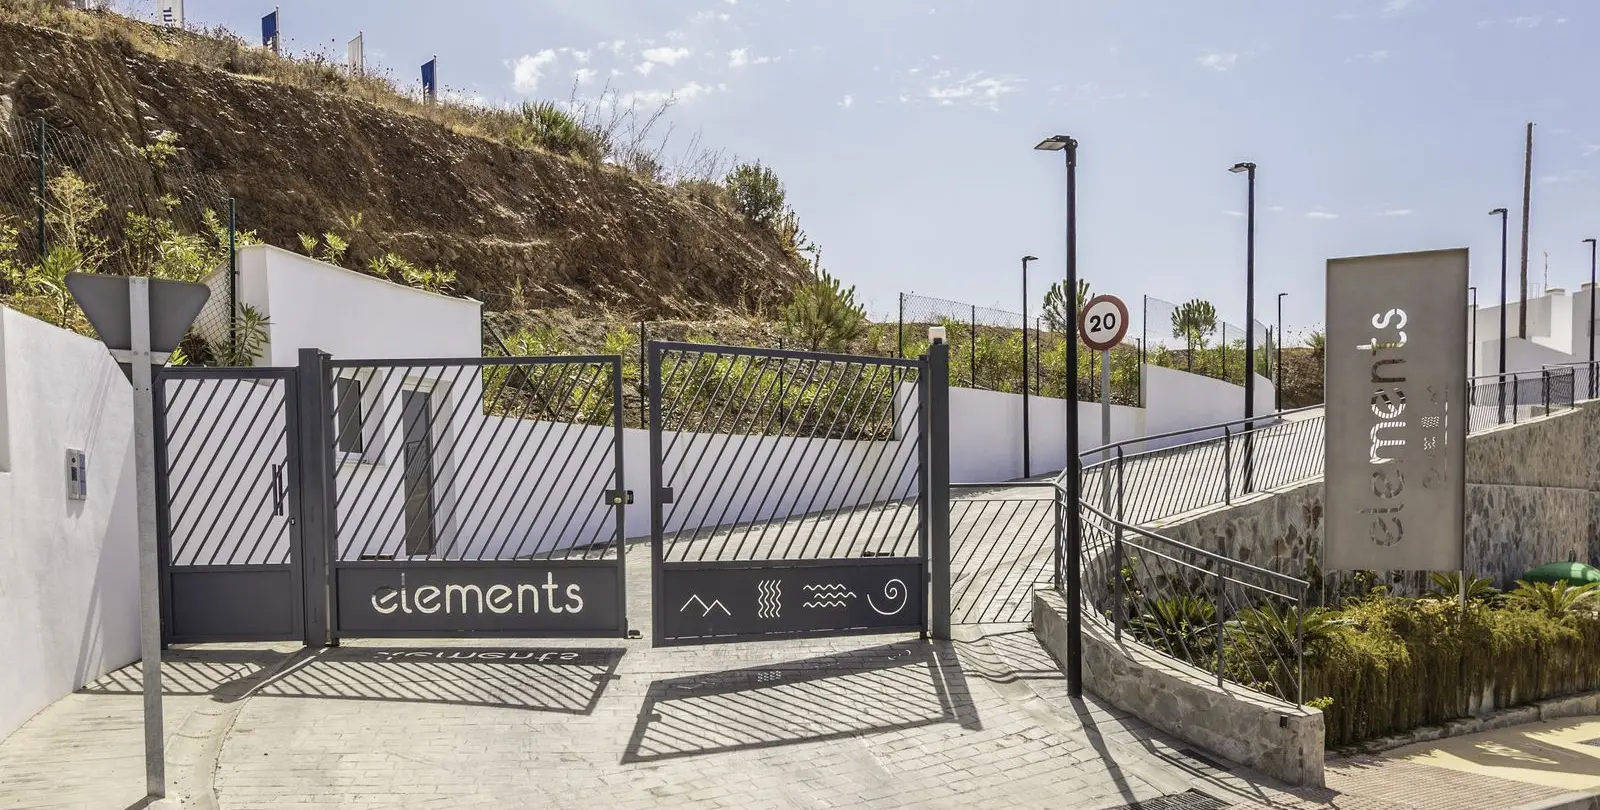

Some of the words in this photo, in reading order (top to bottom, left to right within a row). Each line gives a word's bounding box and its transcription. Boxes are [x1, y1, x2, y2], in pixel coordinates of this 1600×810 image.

[1089, 312, 1116, 333] 20
[1356, 308, 1408, 547] elements
[371, 571, 584, 614] elements
